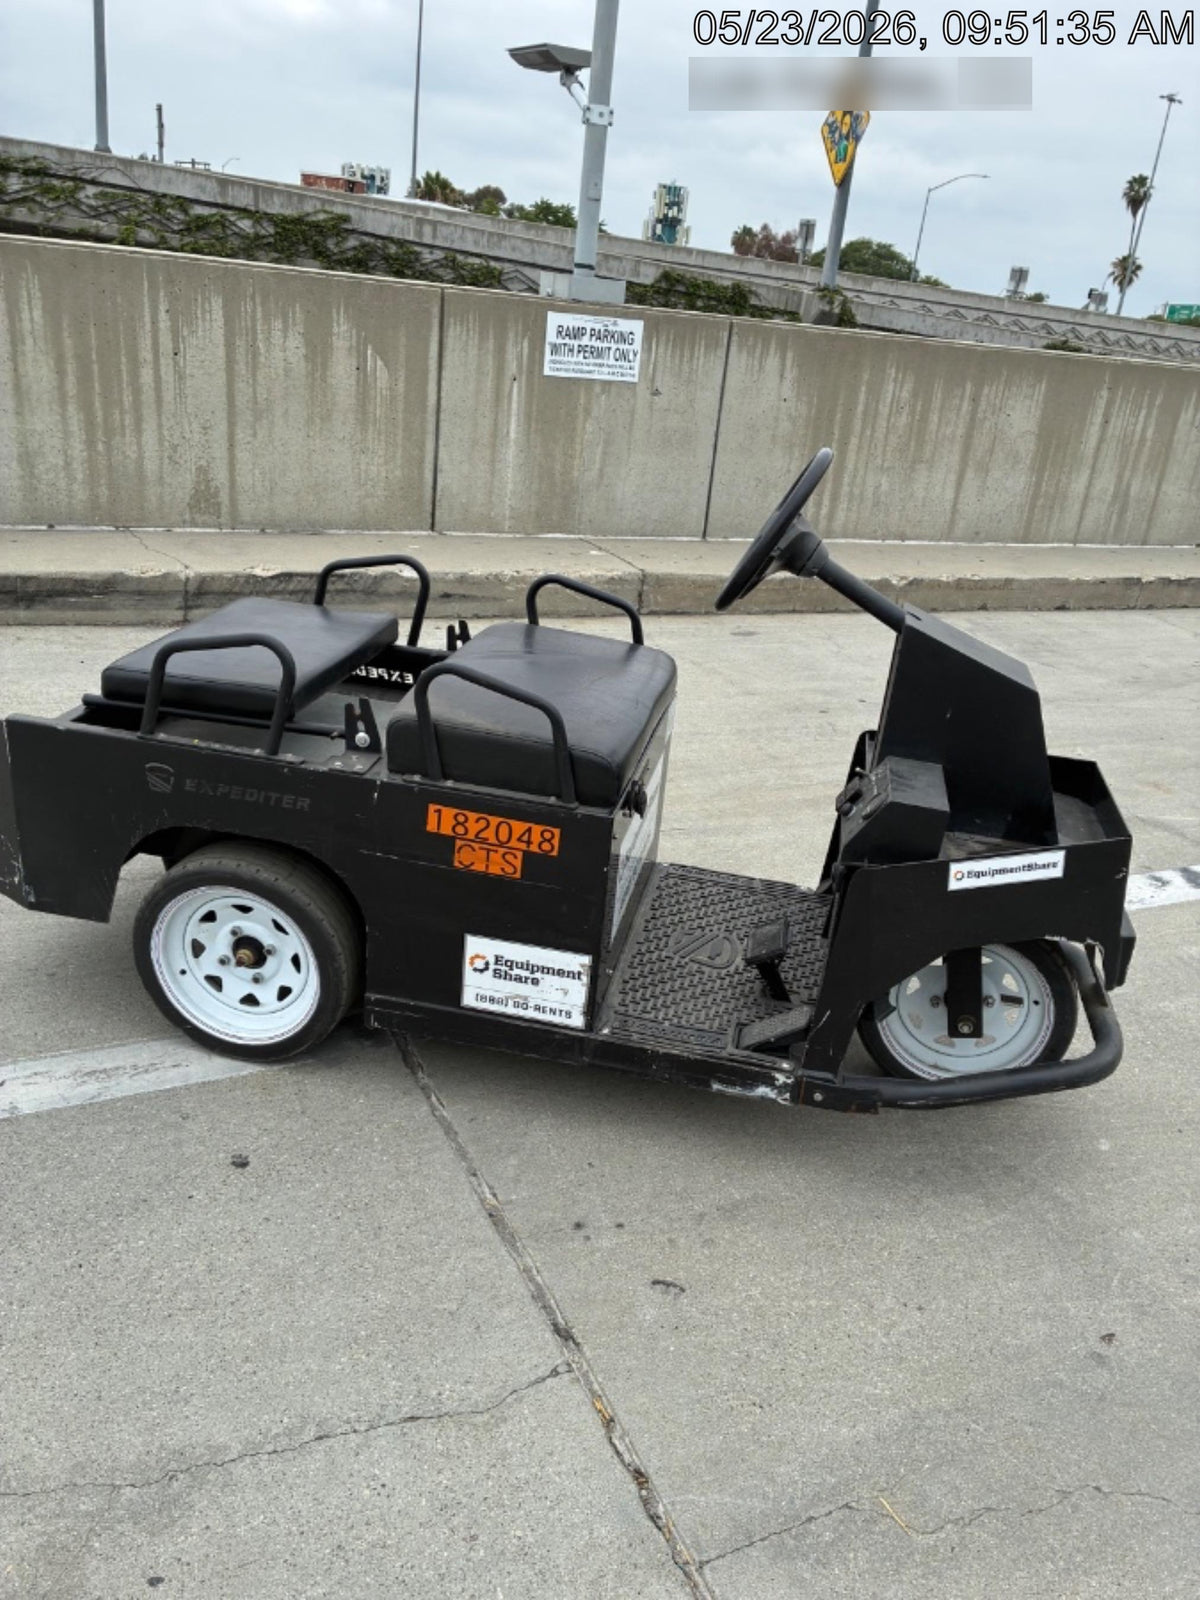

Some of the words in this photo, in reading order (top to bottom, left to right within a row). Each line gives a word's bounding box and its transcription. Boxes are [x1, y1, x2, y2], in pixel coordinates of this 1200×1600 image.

[556, 325, 587, 341] RAMP
[589, 328, 635, 346] PARKING
[548, 342, 575, 358] WITH
[576, 344, 612, 360] PERMIT
[613, 347, 639, 363] ONLY
[184, 778, 312, 812] EXPEDITER
[433, 808, 555, 854] 182048
[457, 843, 518, 876] CTS
[966, 861, 1059, 879] EquipmentShare
[492, 968, 541, 987] Share
[493, 954, 583, 981] Equipment
